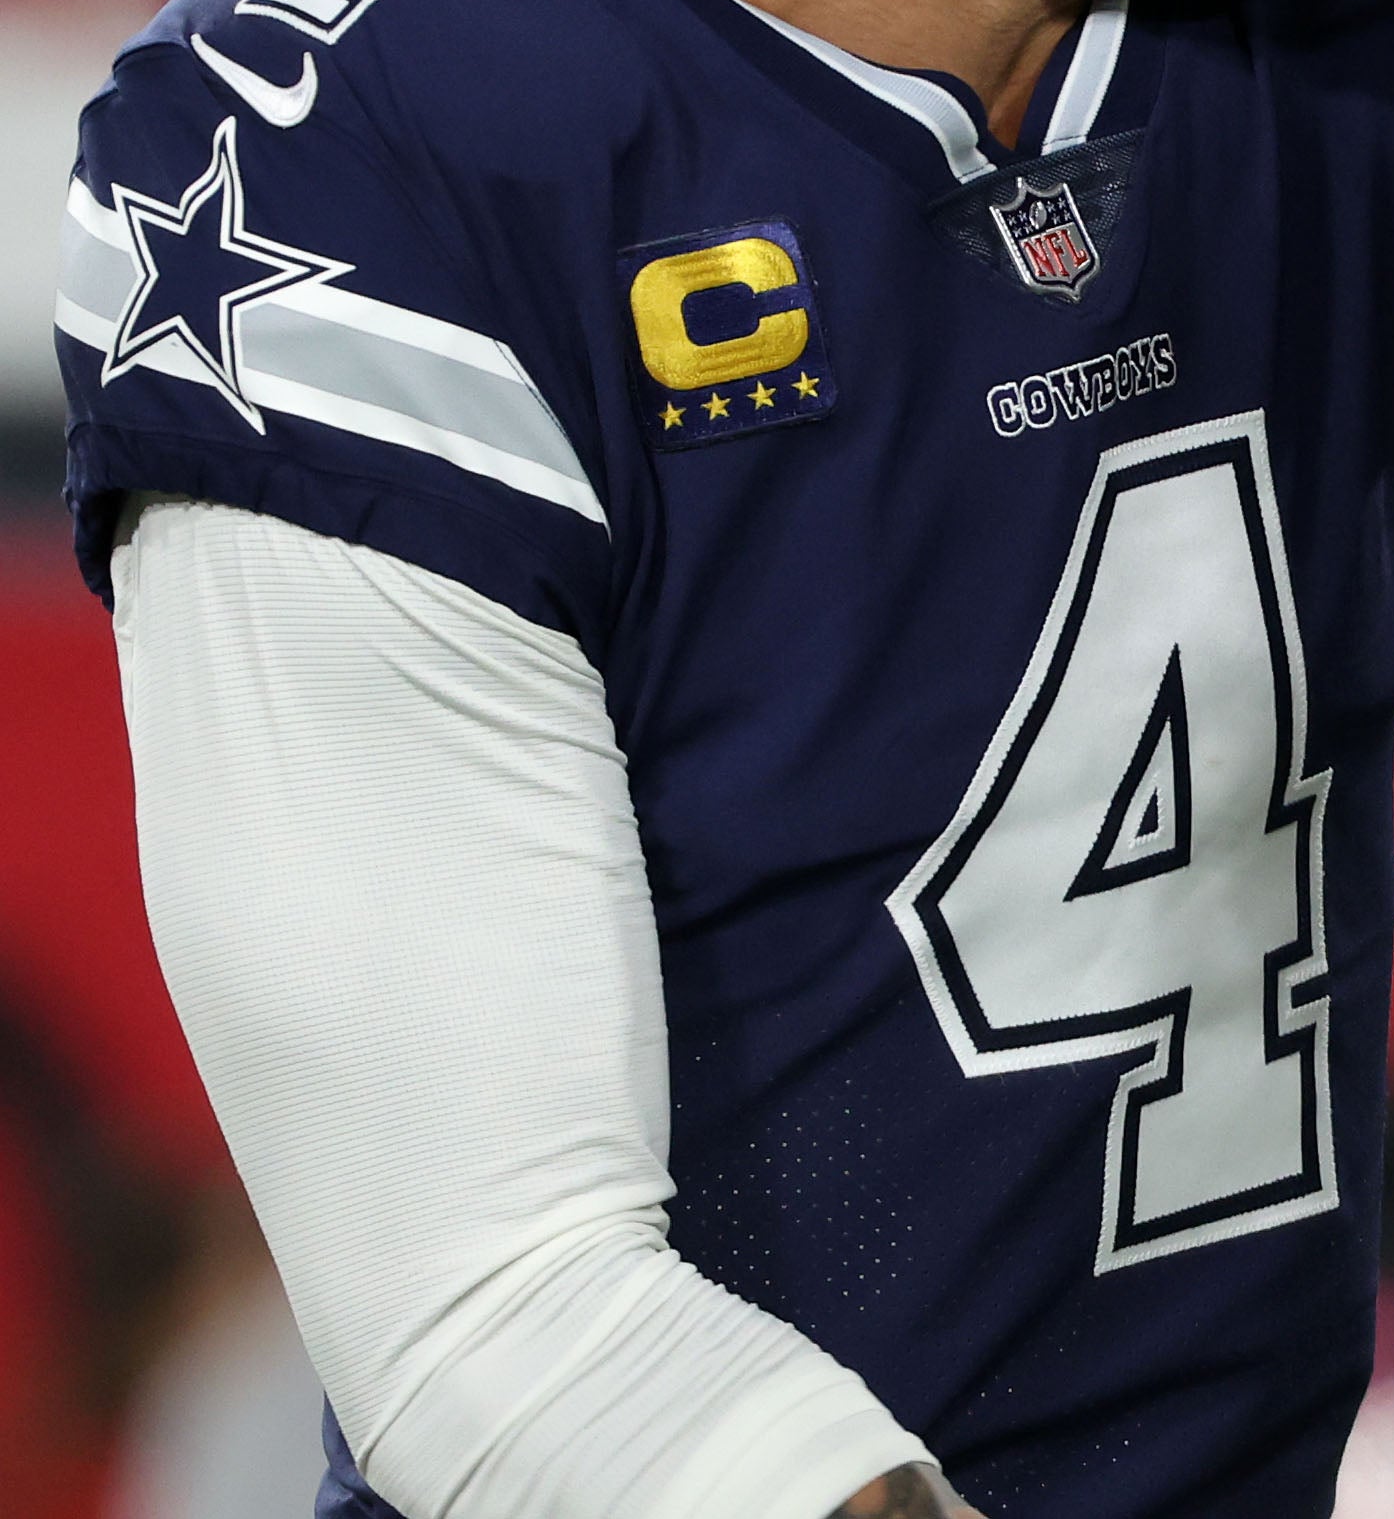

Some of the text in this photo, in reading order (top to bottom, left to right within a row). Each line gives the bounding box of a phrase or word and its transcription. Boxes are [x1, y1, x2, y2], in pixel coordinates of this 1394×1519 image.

[629, 237, 810, 391] C
[1023, 228, 1089, 278] NFL
[986, 332, 1177, 437] COWBOYS
[884, 408, 1340, 1278] 4
